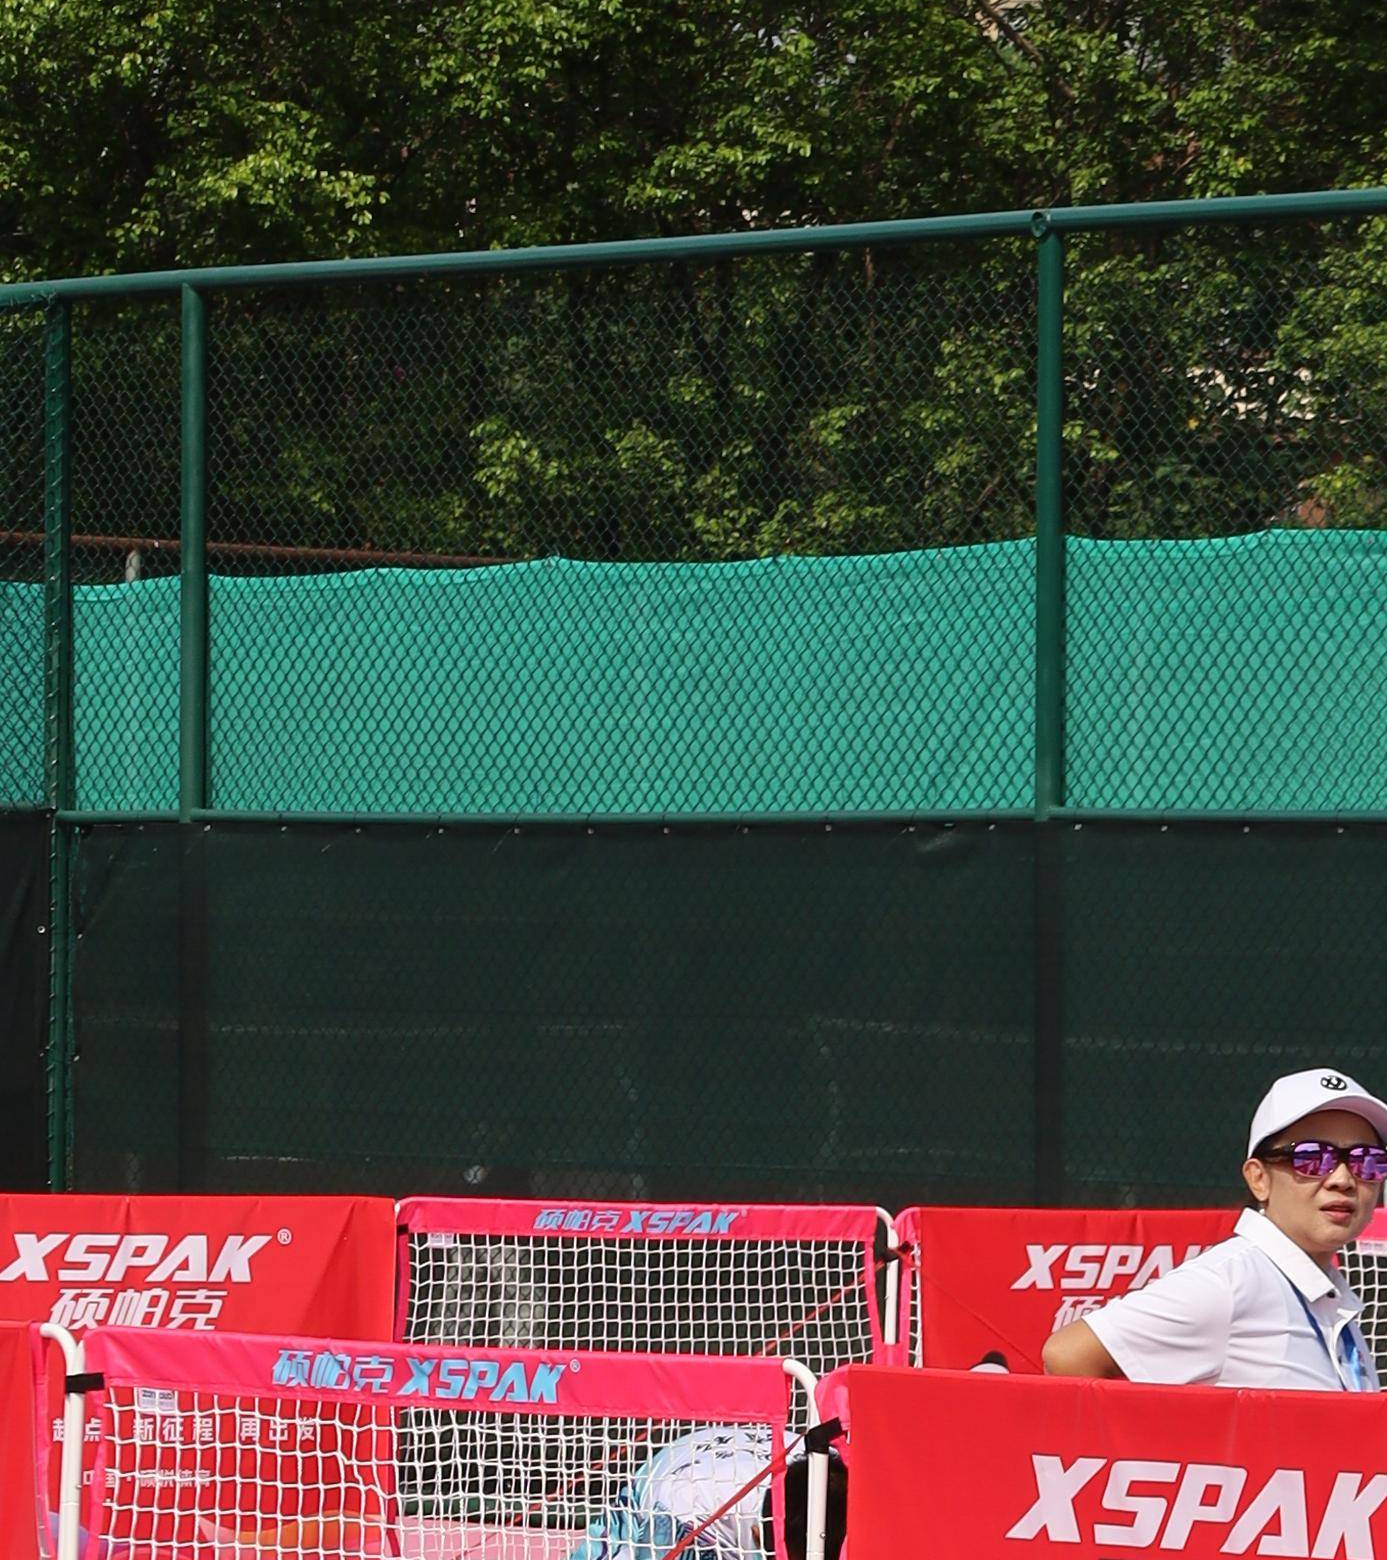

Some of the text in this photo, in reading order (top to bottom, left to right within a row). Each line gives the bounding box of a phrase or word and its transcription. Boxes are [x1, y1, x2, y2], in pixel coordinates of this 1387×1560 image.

[49, 1287, 228, 1331] 硕帕克
[271, 1348, 395, 1395] 硕帕克
